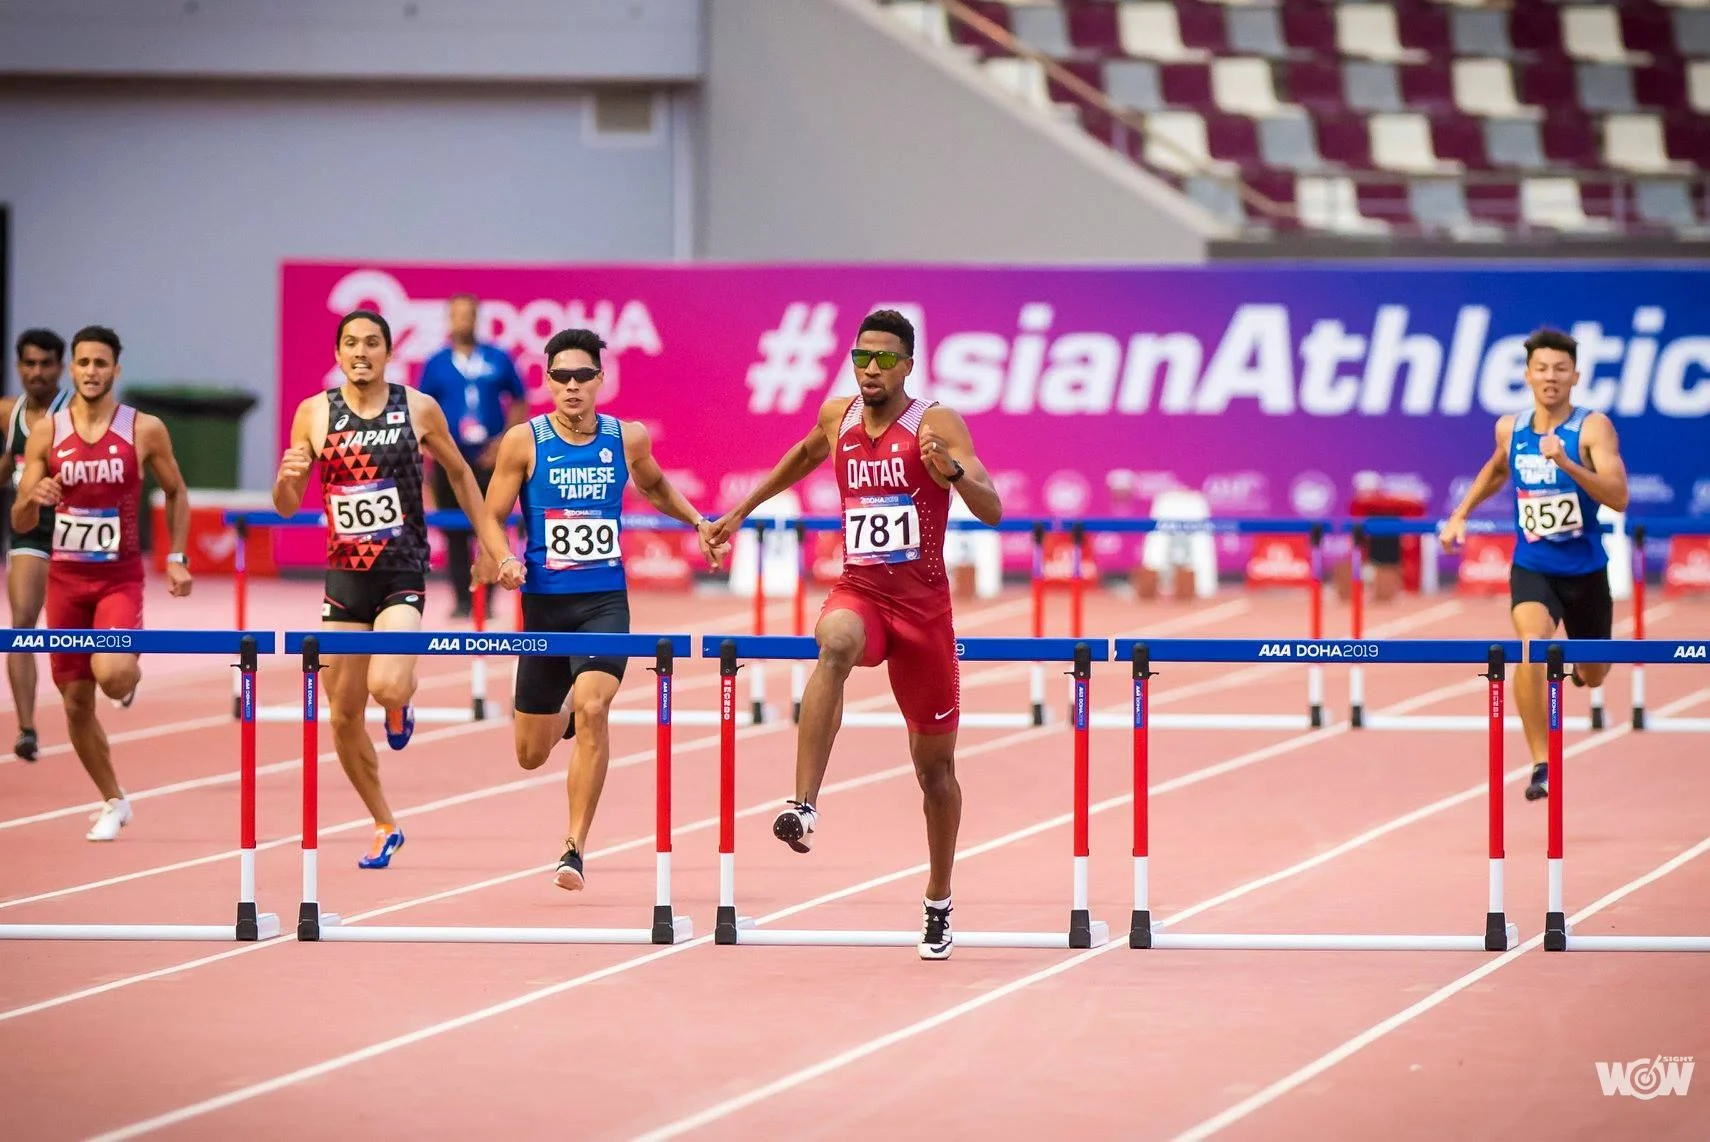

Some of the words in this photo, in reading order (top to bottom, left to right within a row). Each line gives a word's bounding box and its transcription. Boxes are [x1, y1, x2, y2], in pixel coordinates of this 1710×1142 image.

[339, 428, 402, 449] JAPAN
[60, 457, 125, 487] QATAR
[549, 466, 616, 485] CHINESE
[847, 456, 909, 490] QATAR
[557, 483, 608, 501] TAIPEI
[337, 494, 398, 530] 563
[1524, 499, 1578, 532] 852
[60, 519, 115, 550] 770
[551, 524, 614, 556] 839
[850, 511, 911, 549] 781
[12, 635, 45, 648] AAA
[428, 638, 461, 651] AAA
[1258, 644, 1291, 657] AAA
[1673, 645, 1707, 658] AAA
